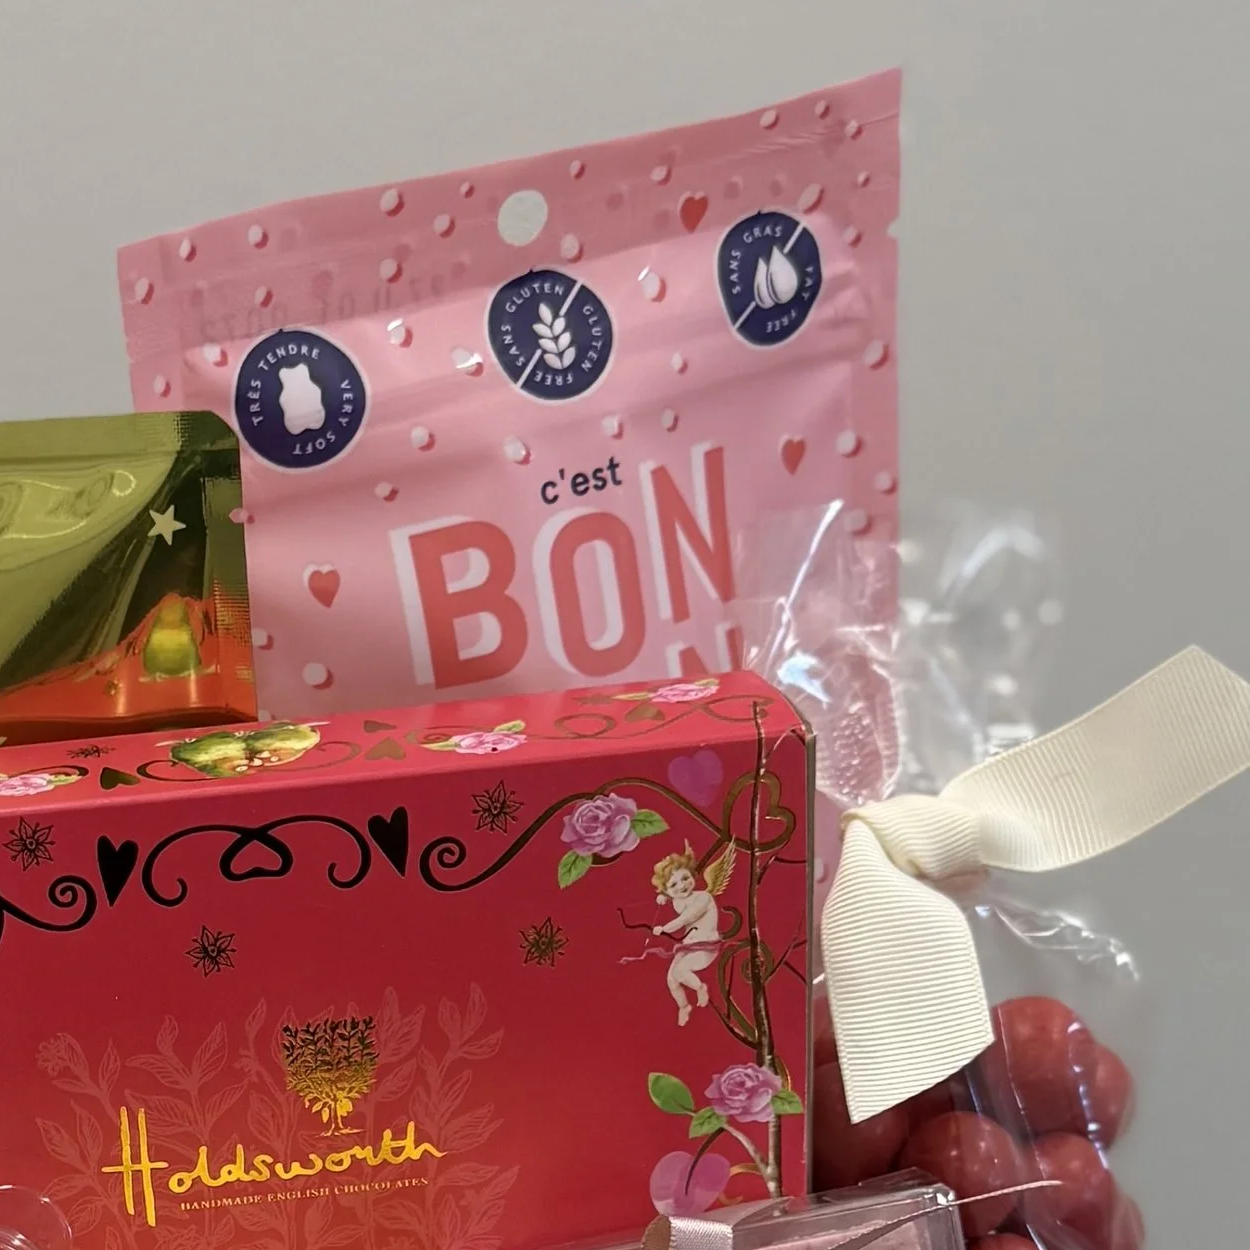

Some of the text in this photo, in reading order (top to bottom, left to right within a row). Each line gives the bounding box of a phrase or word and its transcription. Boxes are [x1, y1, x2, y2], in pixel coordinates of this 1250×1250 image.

[729, 225, 783, 295] SANS GRAS
[501, 282, 565, 367] SANS GLUTEN
[766, 265, 815, 333] FAT FREE
[257, 343, 321, 372] TENDRE
[533, 305, 603, 386] GLUTEN FREE
[292, 379, 354, 455] VERY SOFT
[540, 456, 623, 505] c'est
[389, 440, 736, 691] BON
[100, 1105, 448, 1228] Holdsworth
[180, 1176, 429, 1212] HANDMADE ENGLISH CHOCOLATES
